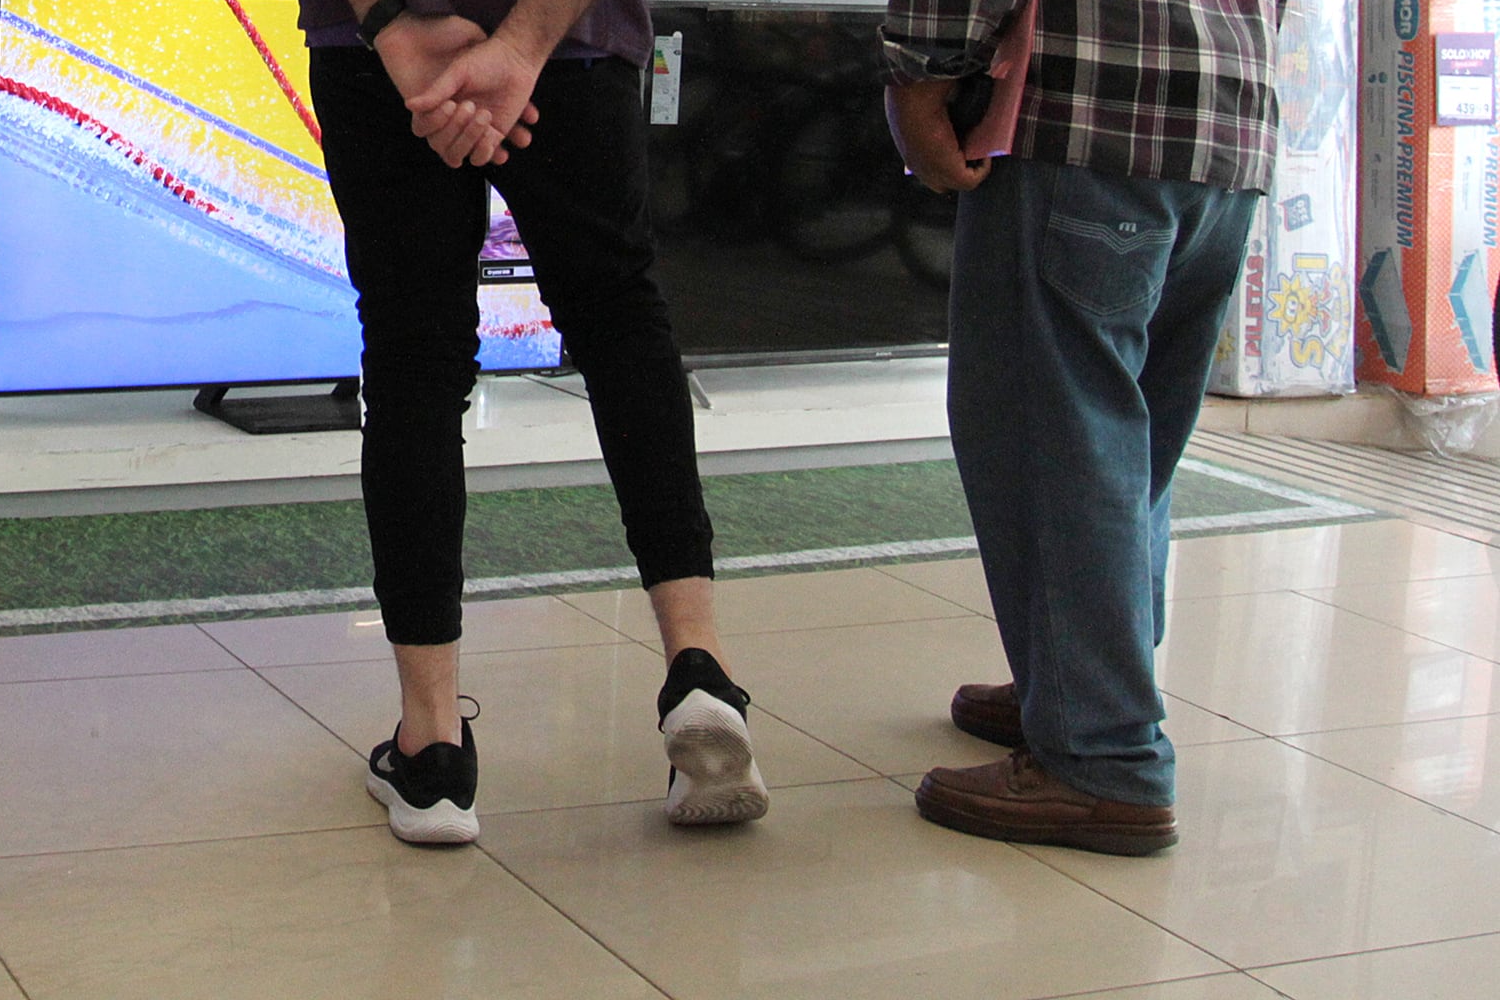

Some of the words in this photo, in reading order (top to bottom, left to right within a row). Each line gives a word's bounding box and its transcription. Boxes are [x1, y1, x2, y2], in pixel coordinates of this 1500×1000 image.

[1397, 50, 1415, 138] PISCINA
[1396, 140, 1415, 249] PREMIUM
[1483, 142, 1499, 248] PREMIUM
[1244, 254, 1264, 358] PILETAS
